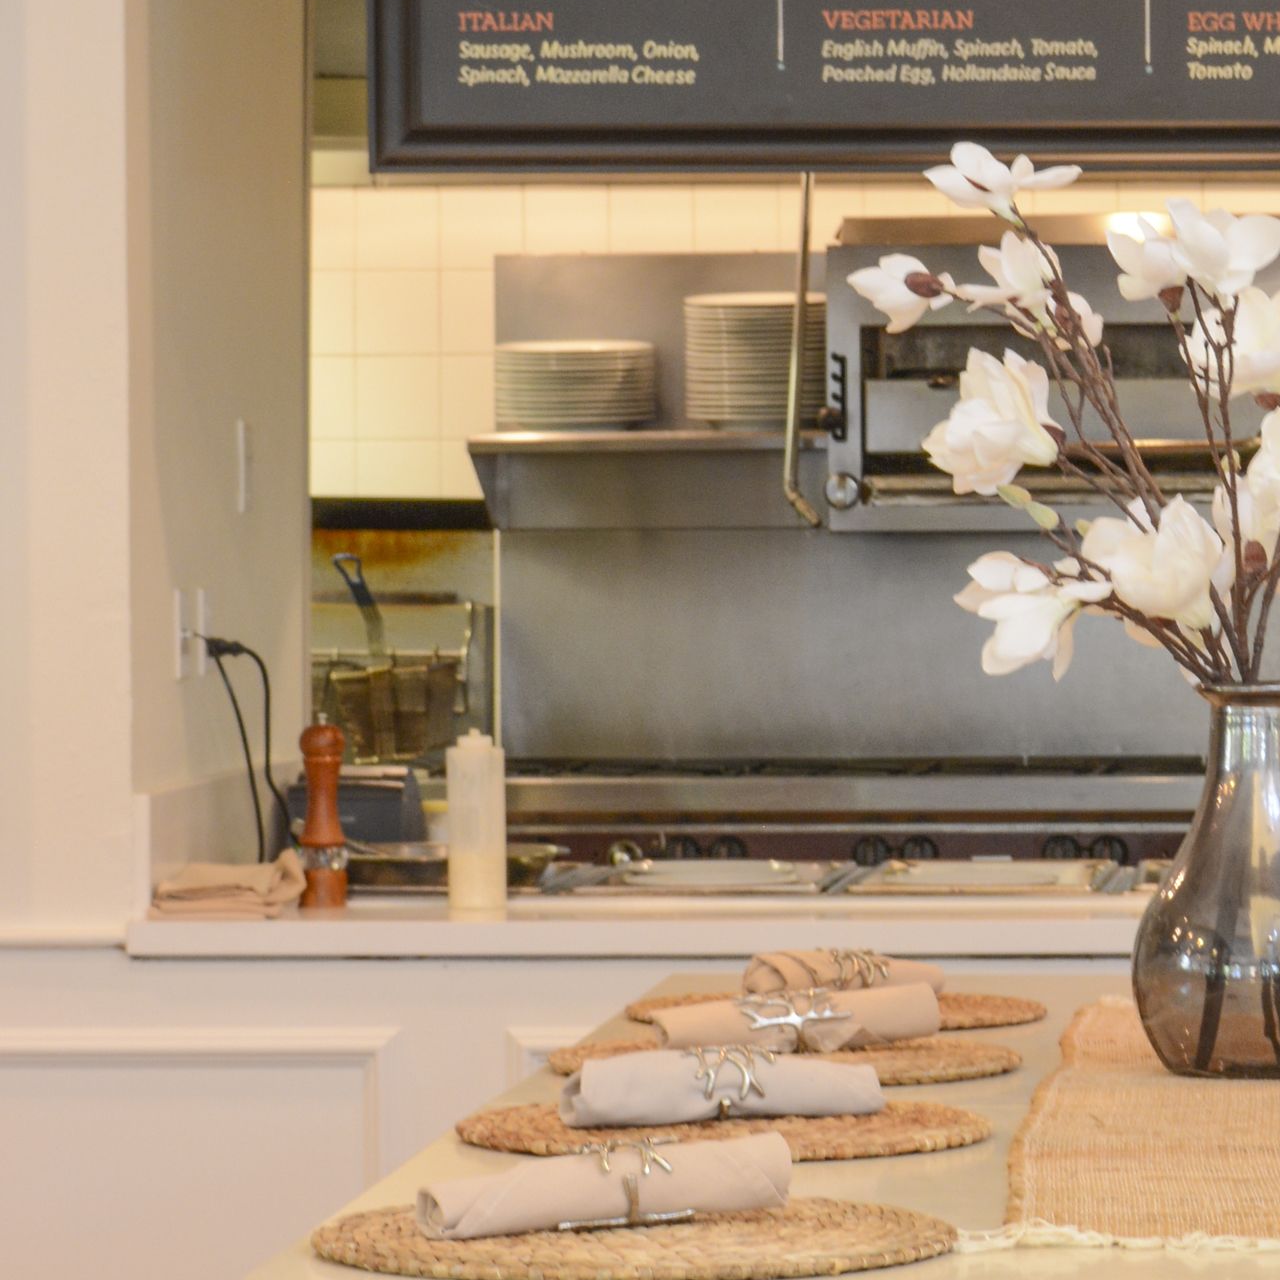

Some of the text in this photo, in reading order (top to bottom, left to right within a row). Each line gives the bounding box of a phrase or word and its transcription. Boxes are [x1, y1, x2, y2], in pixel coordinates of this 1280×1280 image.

[458, 11, 554, 33] ITALIAN
[822, 9, 974, 32] VEGETARIAN
[1187, 11, 1236, 33] EGG
[458, 39, 700, 63] Sausage, Mushroom, Onion,
[1187, 35, 1259, 58] Spinach,
[458, 65, 696, 87] Spinach, Mozzarella Cheese
[1187, 61, 1253, 81] Tomato
